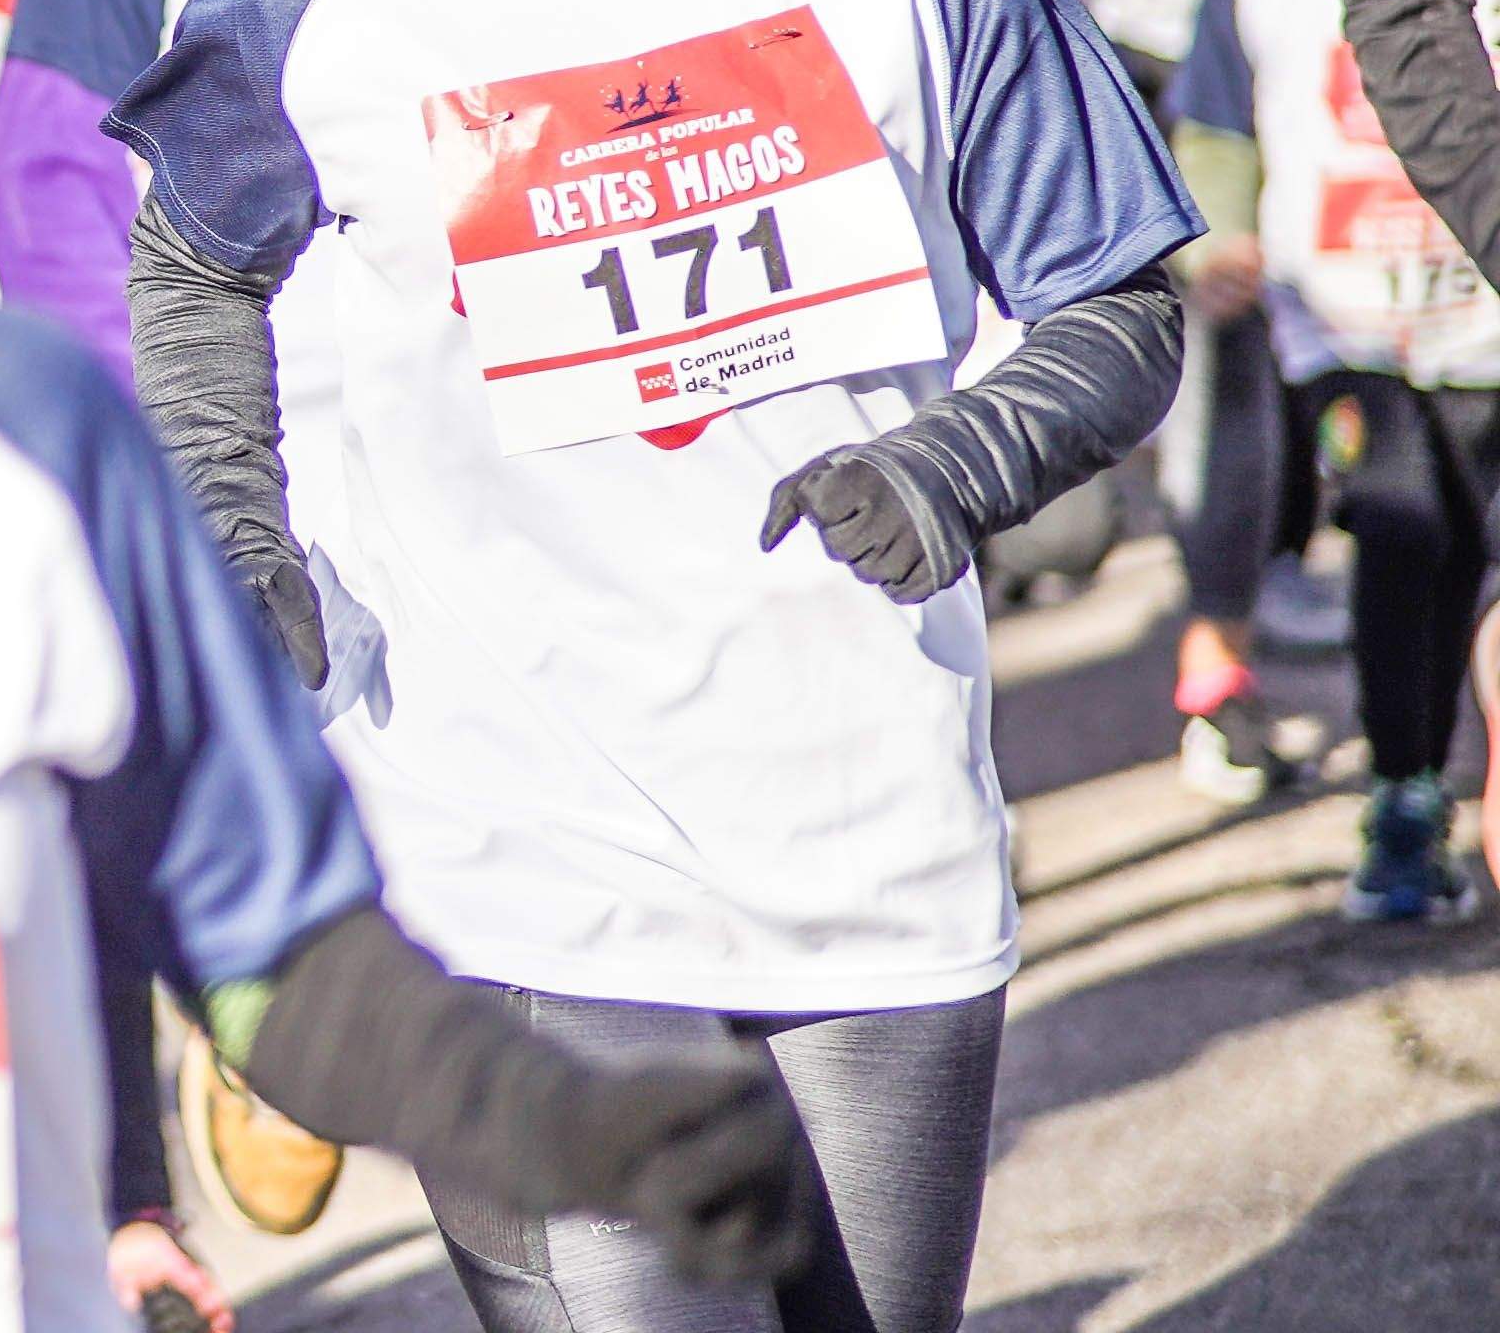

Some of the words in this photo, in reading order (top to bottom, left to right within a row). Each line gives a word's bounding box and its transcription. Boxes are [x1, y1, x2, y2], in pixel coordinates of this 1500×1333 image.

[559, 132, 657, 167] CARRERA
[657, 108, 756, 142] POPULAR
[527, 169, 658, 238] REYES
[664, 125, 806, 211] MAGOS
[581, 205, 793, 336] 171
[679, 326, 791, 371] Comunidad
[685, 375, 710, 393] de
[718, 346, 795, 382] Madrid
